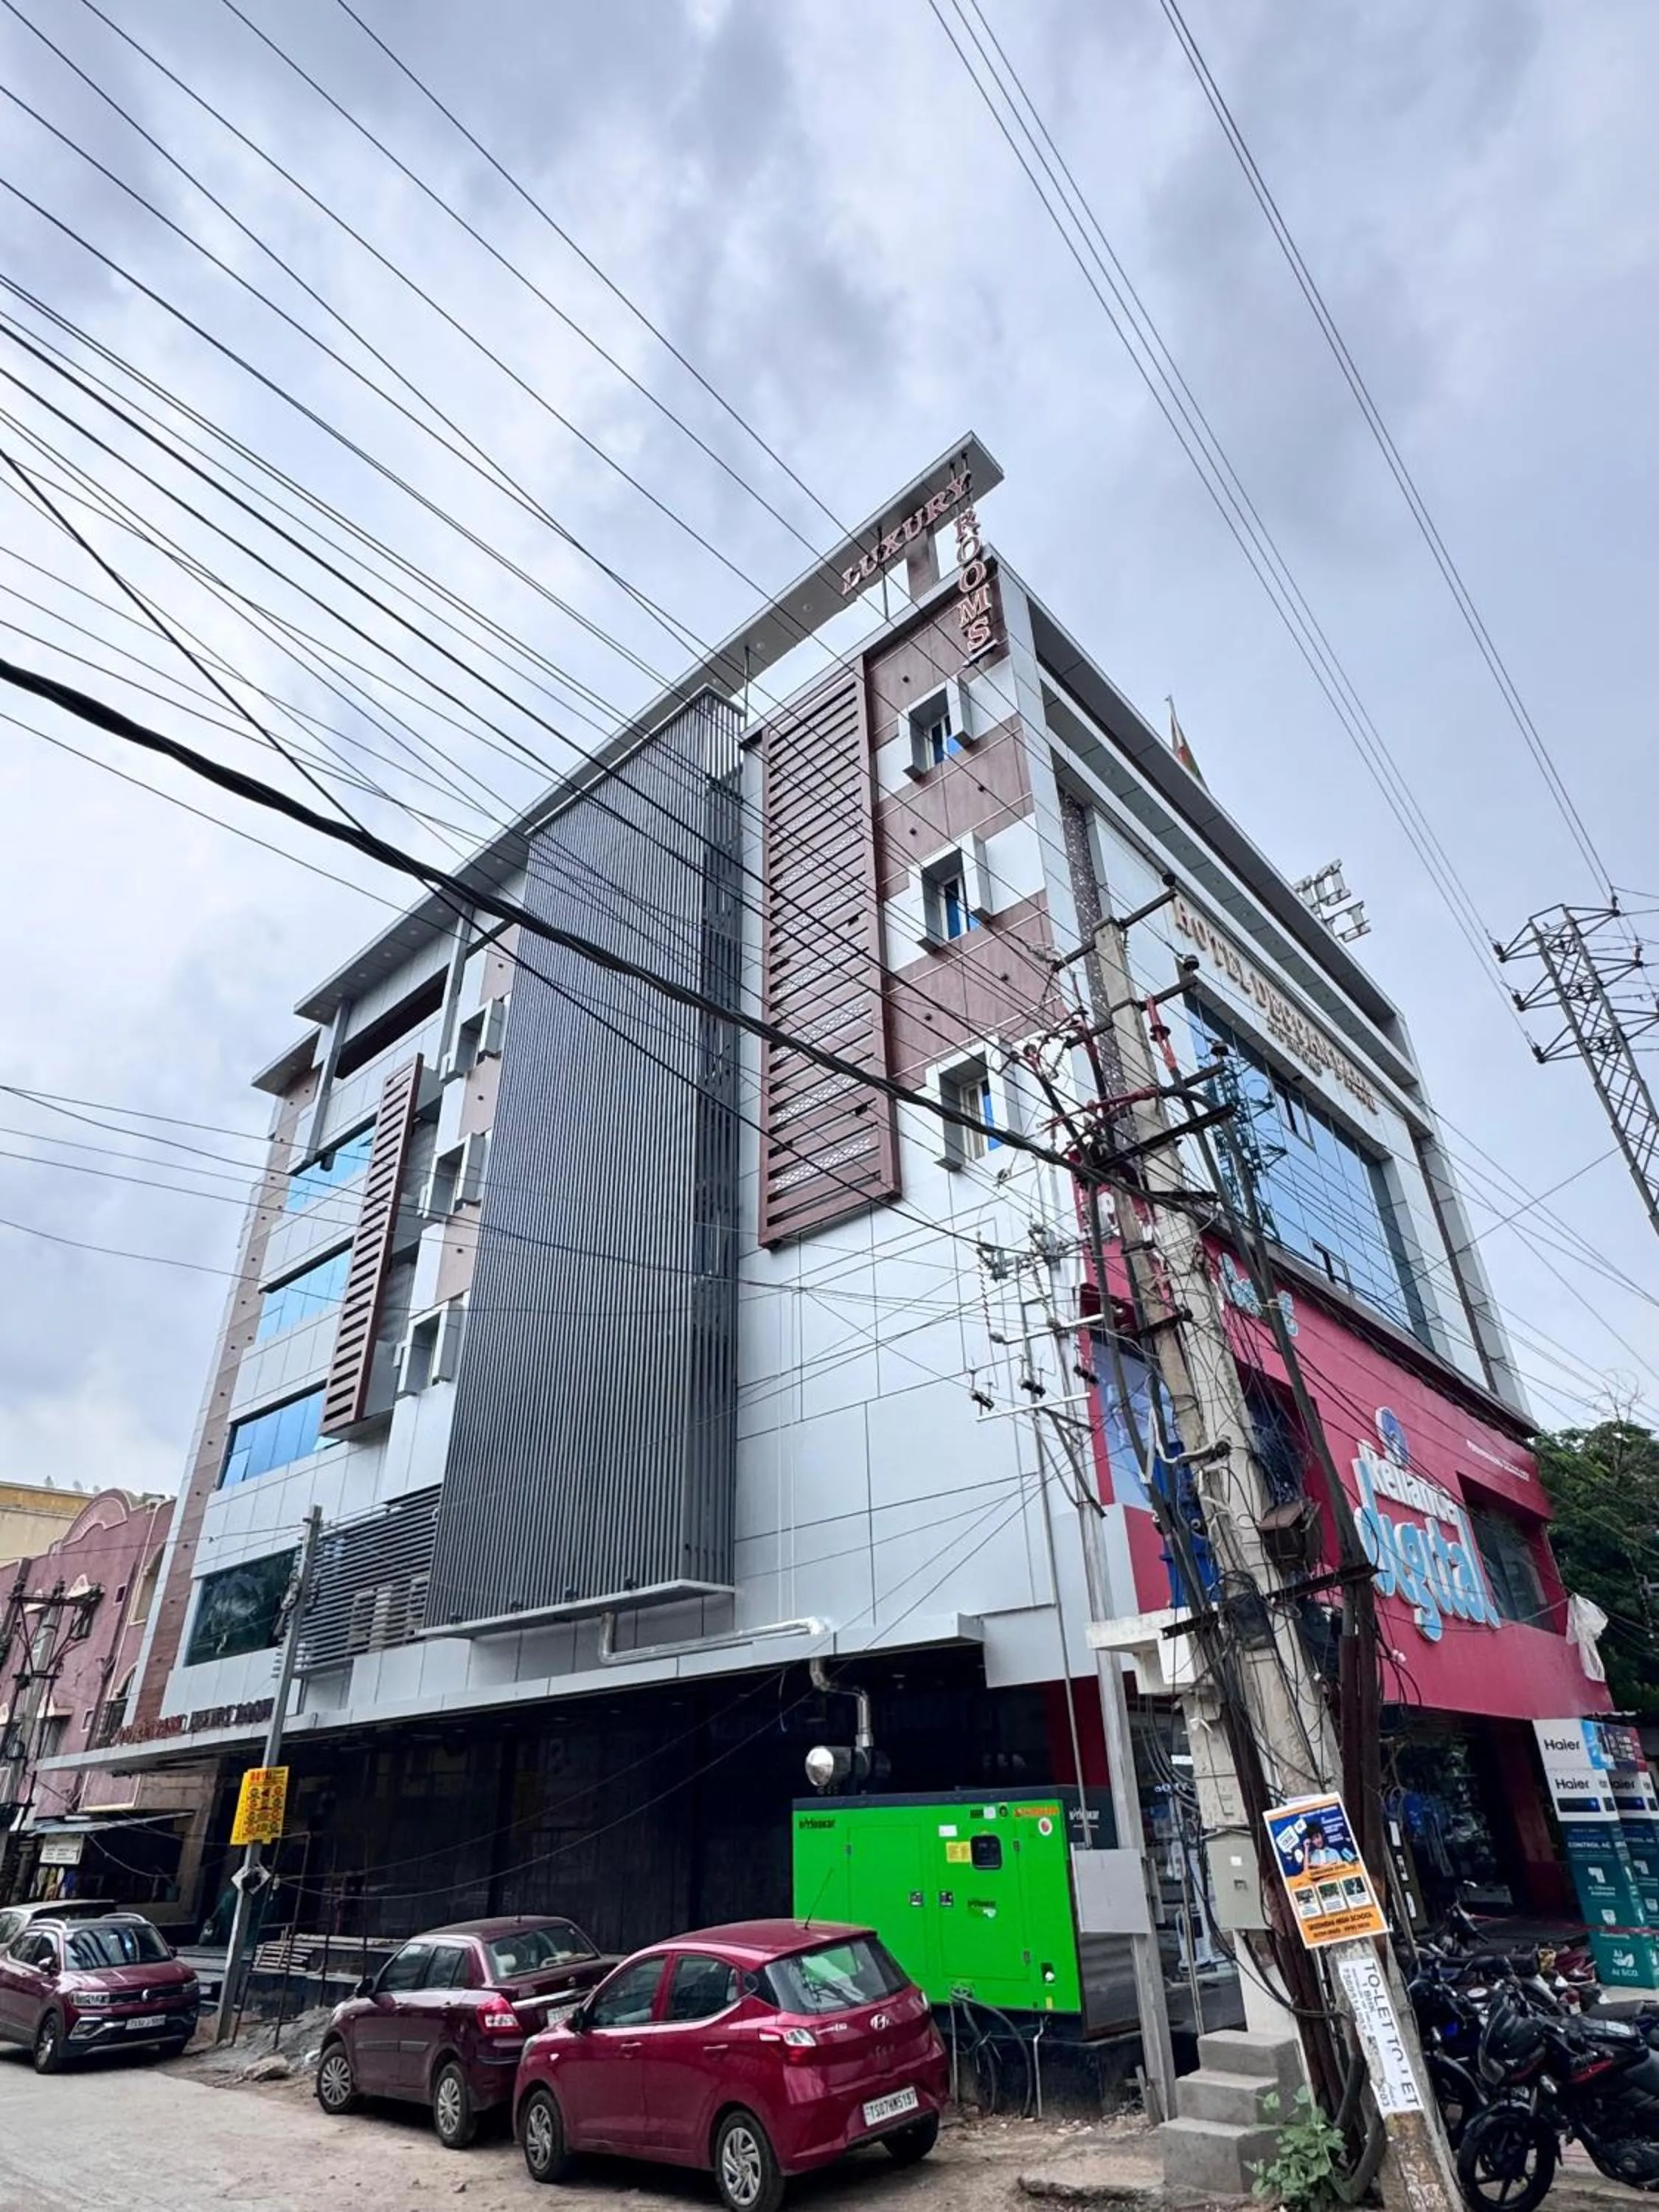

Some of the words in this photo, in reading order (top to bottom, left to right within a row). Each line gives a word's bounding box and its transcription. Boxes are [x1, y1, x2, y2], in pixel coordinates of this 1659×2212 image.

[841, 470, 971, 596] LUXURY
[954, 507, 992, 652] ROOMS
[1543, 1738, 1580, 1751] Haier
[1554, 1778, 1590, 1790] Haier
[1610, 1778, 1635, 1790] aier
[1364, 1962, 1395, 2031] TO-LET
